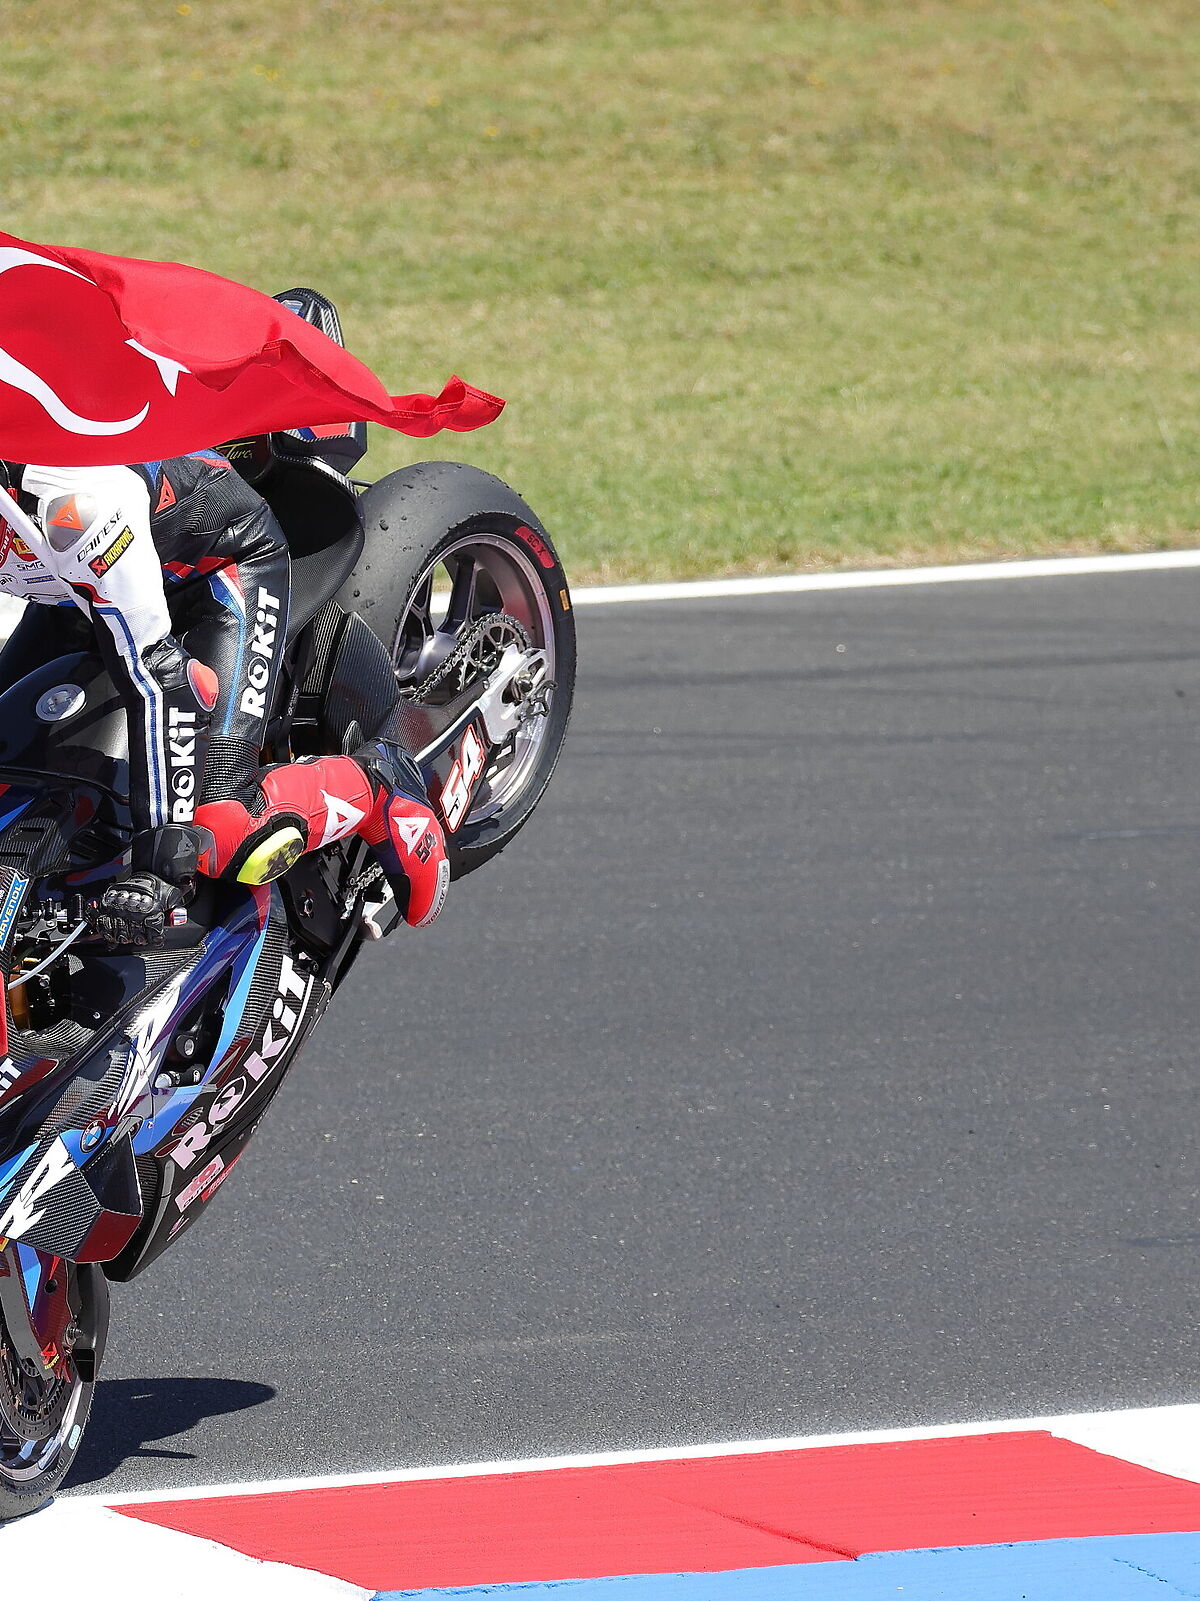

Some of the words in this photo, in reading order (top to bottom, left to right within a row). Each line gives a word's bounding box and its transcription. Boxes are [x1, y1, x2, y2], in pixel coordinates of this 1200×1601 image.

[77, 508, 123, 563] DAINESE
[439, 723, 485, 834] 54
[414, 830, 438, 865] 54
